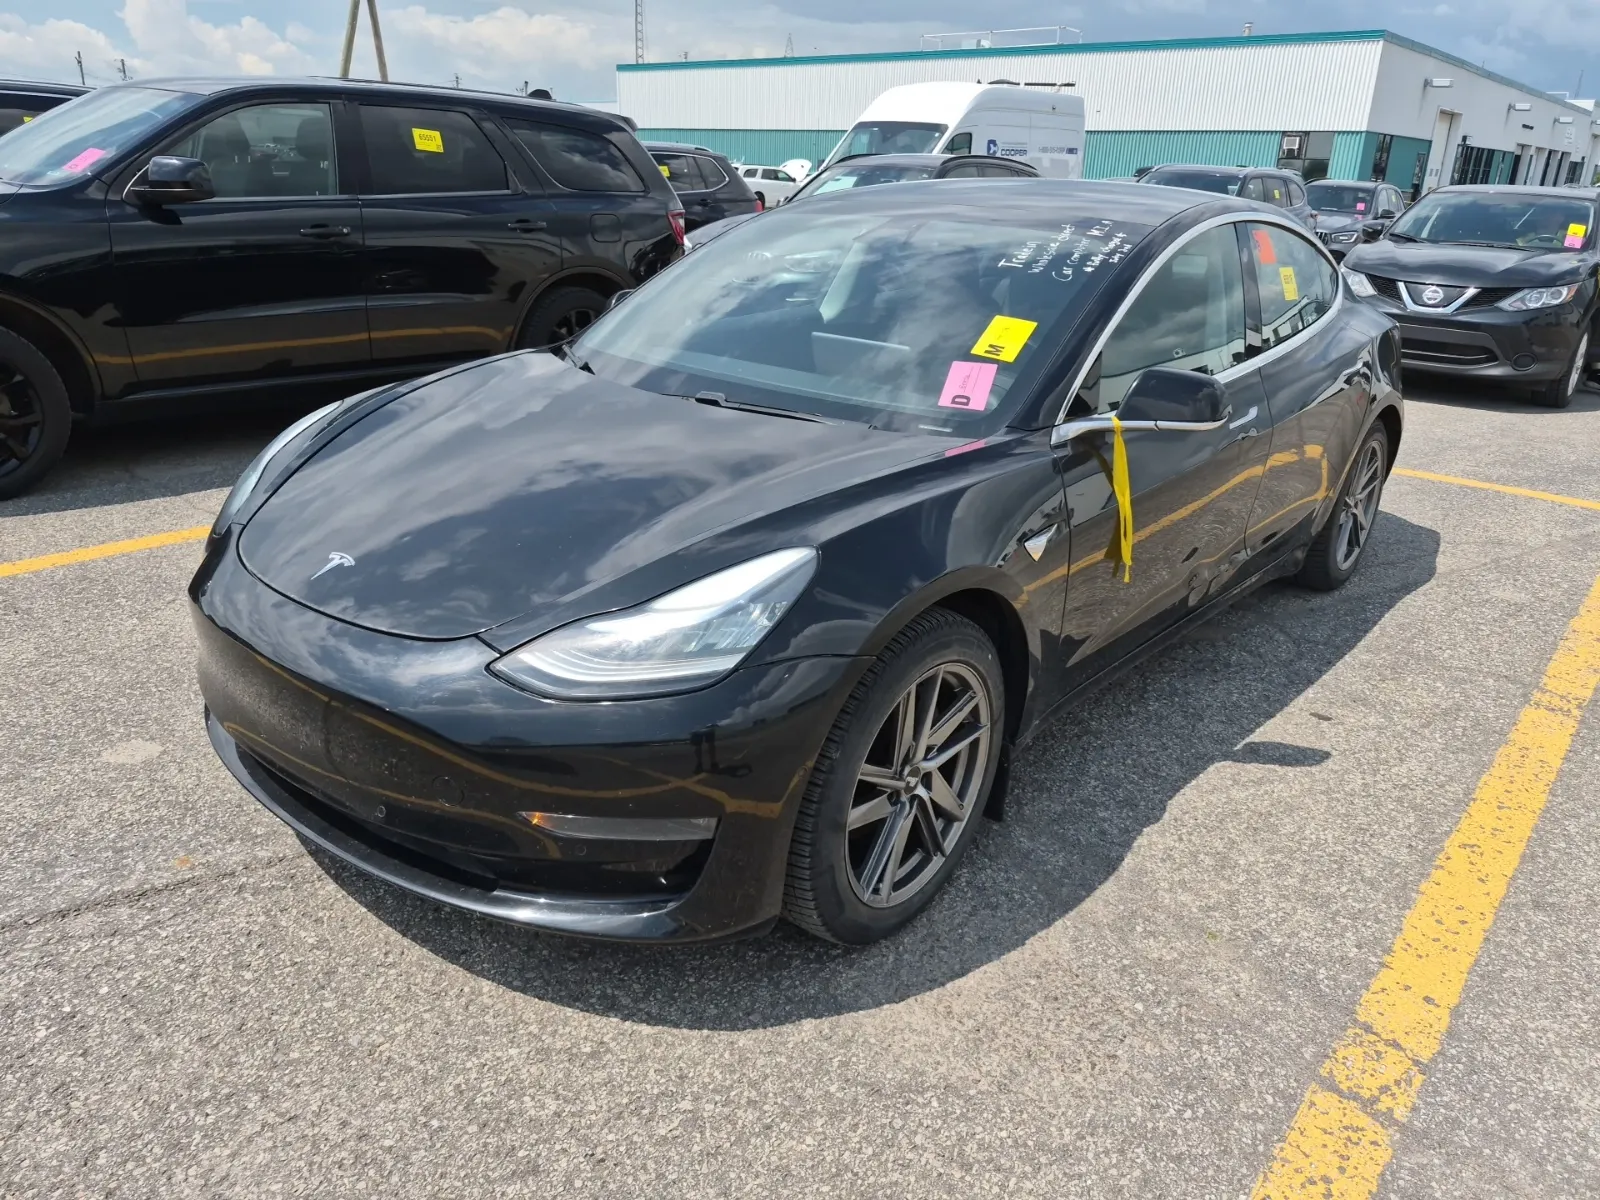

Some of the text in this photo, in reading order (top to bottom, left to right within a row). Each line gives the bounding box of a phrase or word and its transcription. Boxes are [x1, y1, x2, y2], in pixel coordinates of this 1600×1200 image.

[1000, 148, 1027, 156] COOPER
[1051, 266, 1074, 282] Car
[984, 344, 1005, 356] M
[951, 395, 971, 406] D
